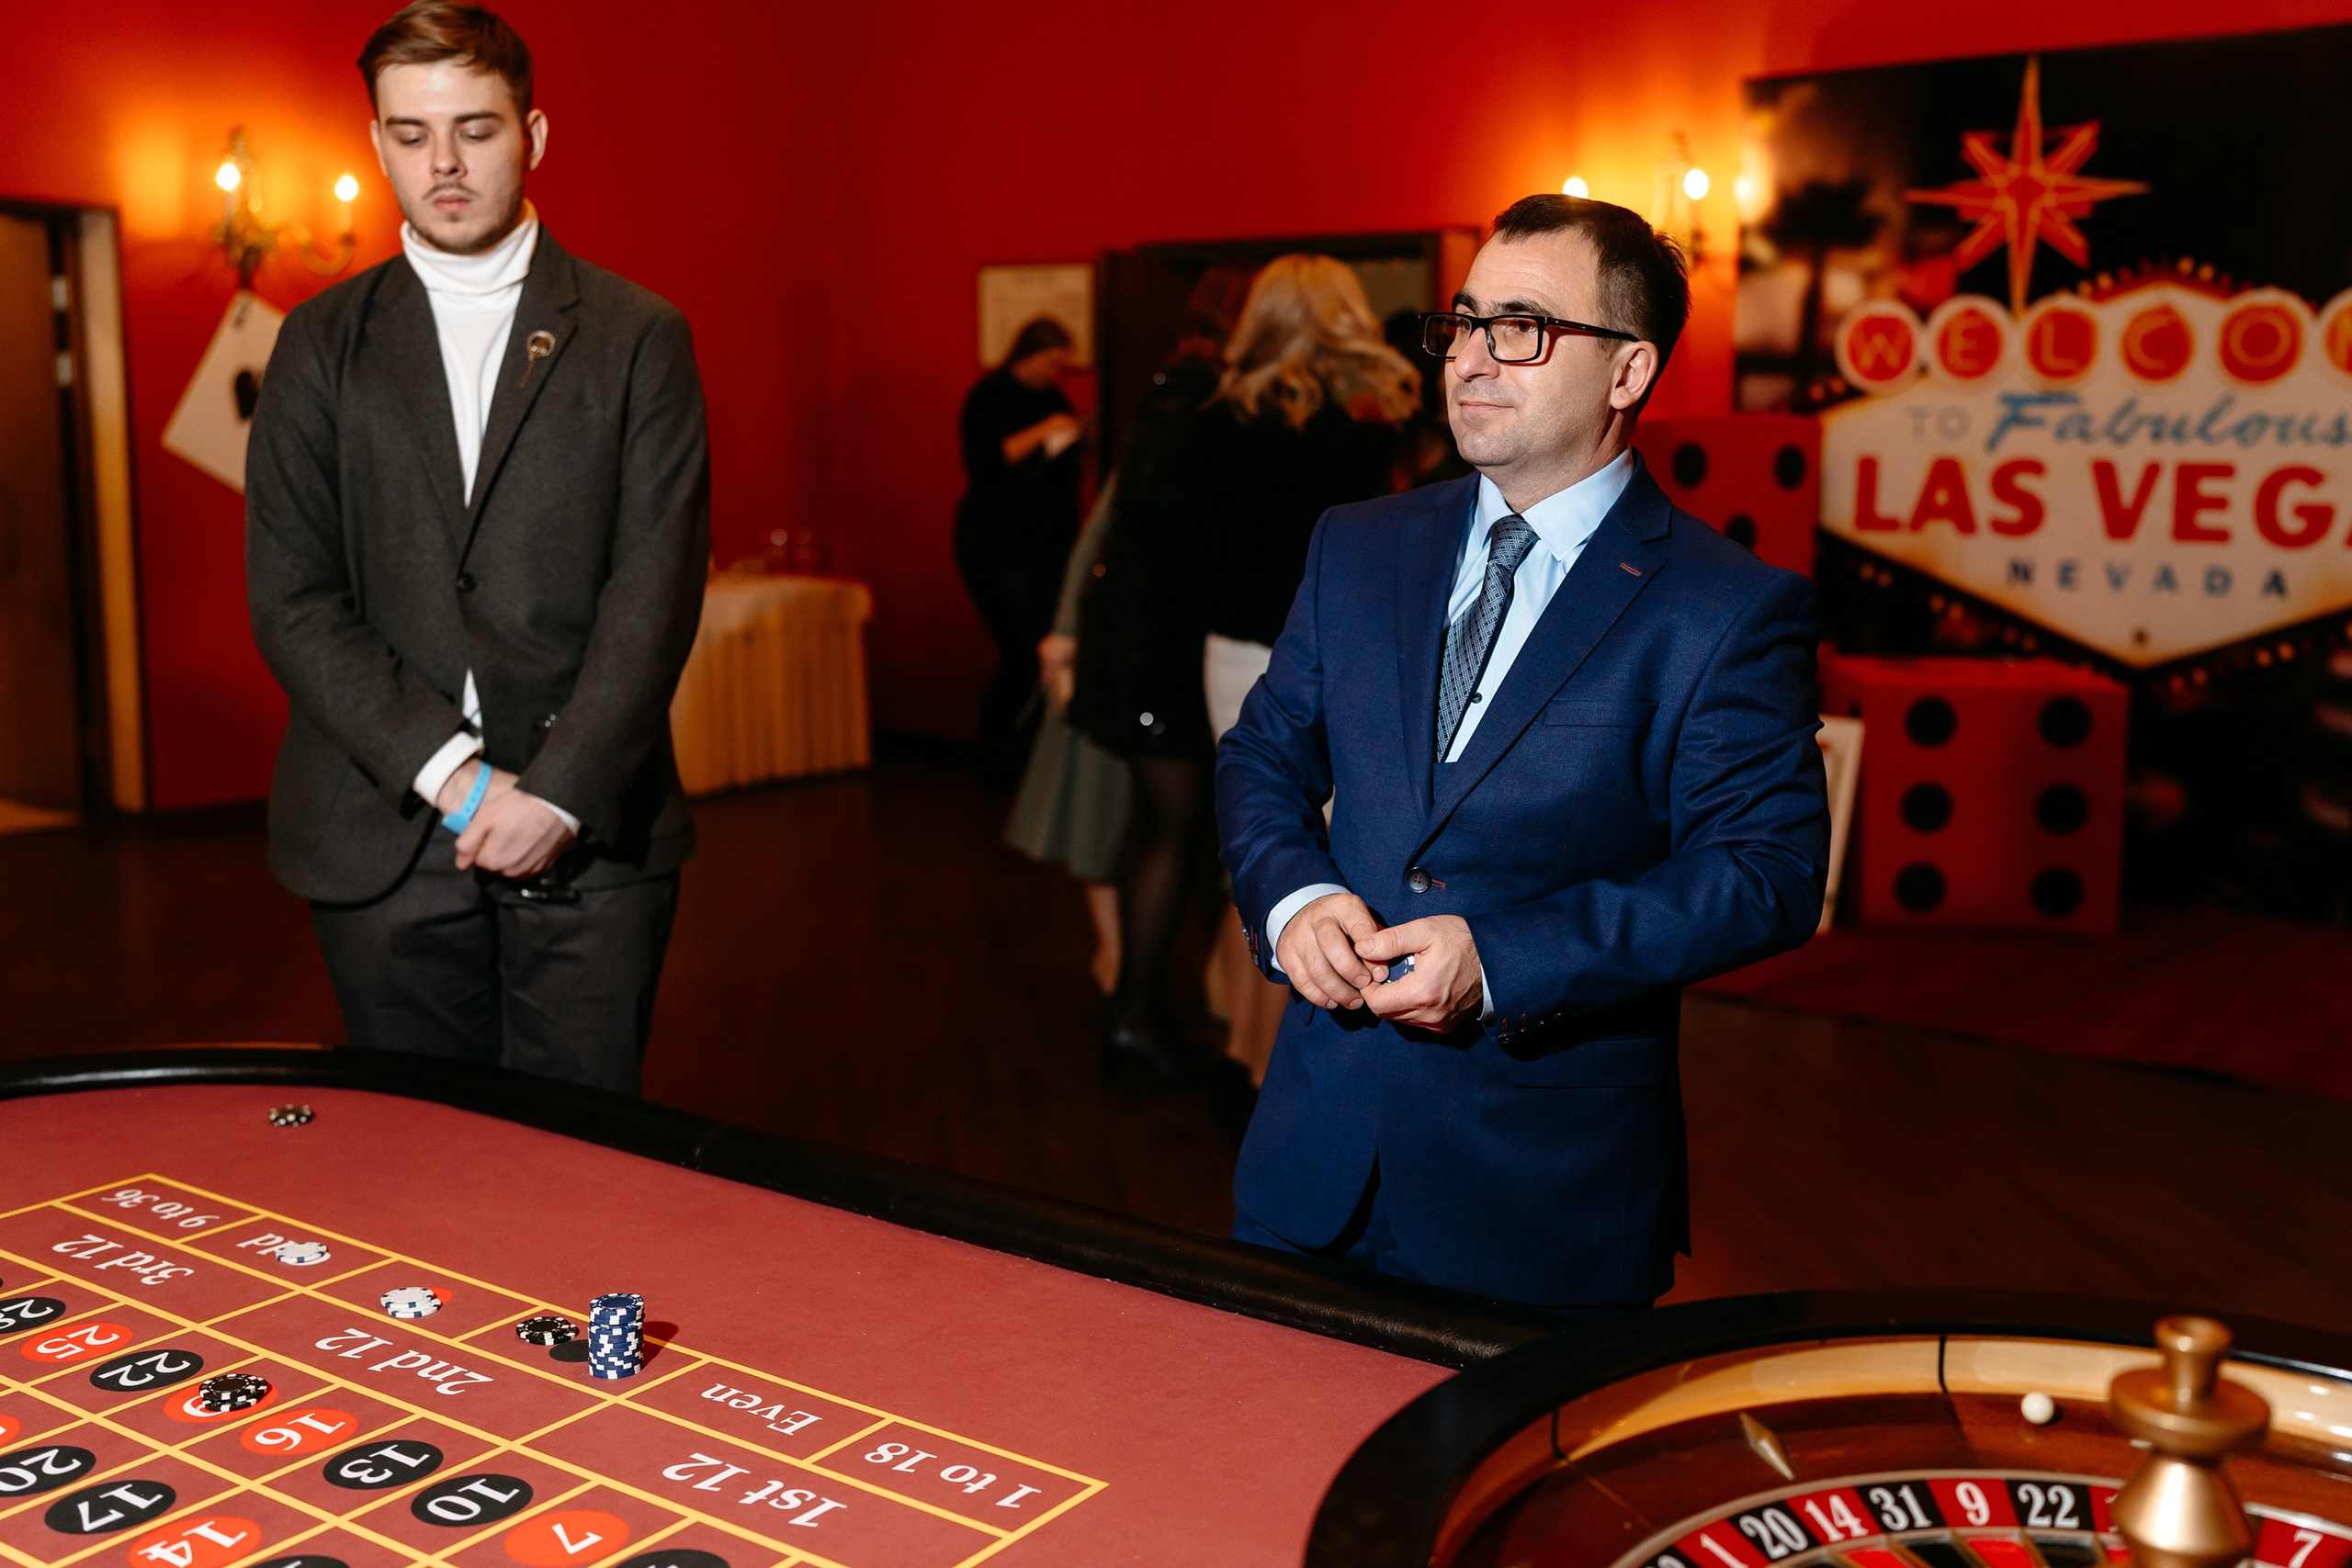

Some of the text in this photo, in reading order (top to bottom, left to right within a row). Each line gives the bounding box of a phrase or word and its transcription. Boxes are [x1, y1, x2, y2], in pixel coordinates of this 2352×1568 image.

[1905, 404, 1973, 441] TO
[1854, 457, 2352, 548] LAS VEG
[2008, 559, 2290, 598] NEVADA
[101, 1189, 161, 1209] 36
[150, 1201, 195, 1220] to
[51, 1234, 195, 1285] 3rd 12
[36, 1325, 120, 1359] 25
[314, 1327, 494, 1395] 2nd 12
[97, 1351, 191, 1387] 22
[254, 1412, 346, 1451] 16
[700, 1382, 823, 1436] Even
[339, 1443, 431, 1484] 13
[864, 1442, 1042, 1509] 1 to 18
[76, 1483, 164, 1532] 17
[425, 1477, 520, 1522] 10
[662, 1451, 848, 1529] 1st 12
[1868, 1483, 1932, 1531] 31
[1954, 1481, 1991, 1527] 9
[2017, 1483, 2080, 1529] 22
[551, 1523, 603, 1555] 7
[1739, 1507, 1800, 1560] 20
[1804, 1494, 1869, 1542] 14
[137, 1519, 248, 1568] 14
[1700, 1532, 1750, 1568] 1
[2287, 1529, 2324, 1568] 7
